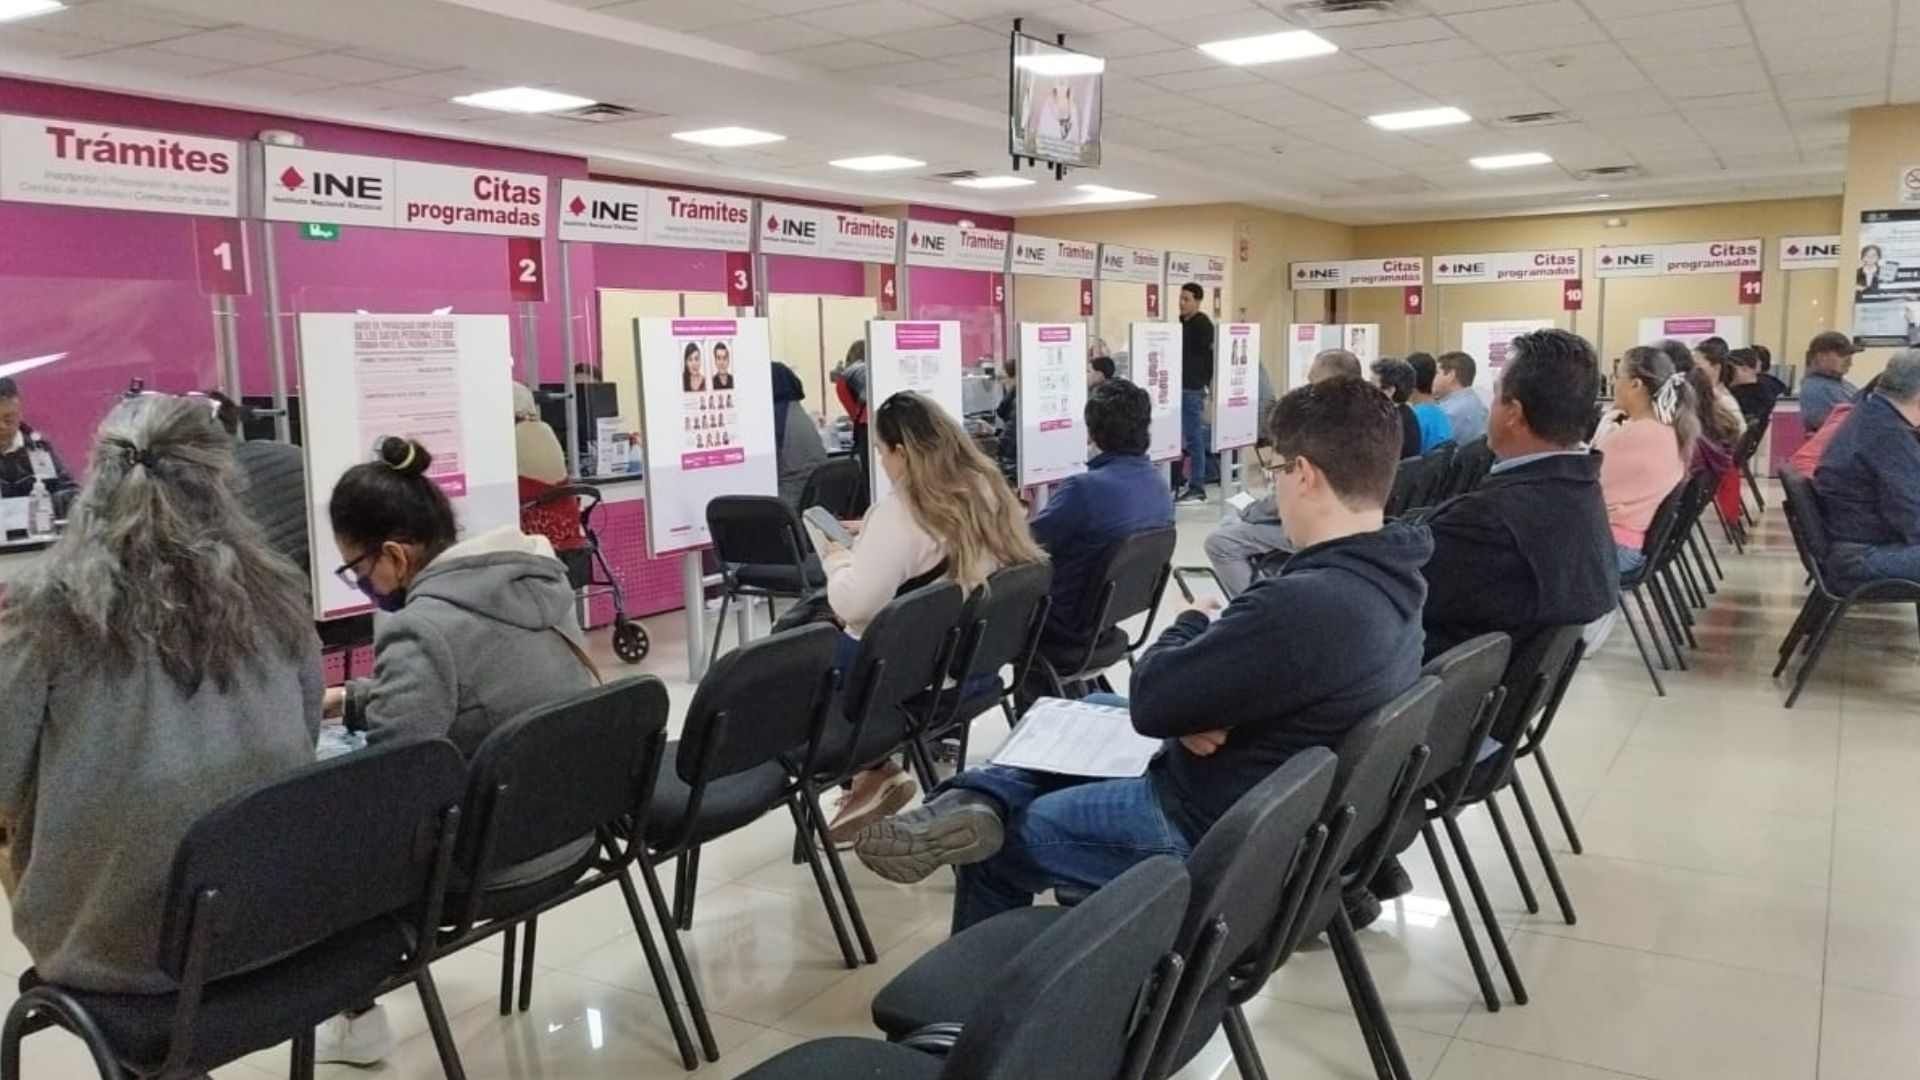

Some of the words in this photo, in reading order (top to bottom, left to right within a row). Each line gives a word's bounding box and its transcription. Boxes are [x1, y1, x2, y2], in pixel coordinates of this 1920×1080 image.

[46, 126, 229, 174] Trámites
[313, 172, 382, 201] INE
[474, 175, 541, 205] Citas
[407, 202, 540, 226] programadas
[592, 200, 638, 222] INE
[667, 196, 748, 223] Trámites
[782, 219, 816, 238] INE
[836, 215, 895, 239] Trámites
[921, 234, 945, 251] INE
[1709, 243, 1757, 257] Citas
[213, 242, 234, 271] 1
[1025, 246, 1046, 261] INE
[1534, 253, 1576, 266] Citas
[1617, 254, 1654, 265] INE
[519, 259, 537, 283] 2
[1383, 260, 1420, 273] Citas
[1453, 262, 1485, 273] INE
[1667, 257, 1757, 271] programadas
[734, 270, 748, 290] 3
[1309, 268, 1339, 279] INE
[1497, 266, 1576, 279] programadas
[884, 280, 894, 297] 4
[995, 286, 1003, 301] 5
[1566, 289, 1581, 301] 10
[1743, 281, 1761, 294] 11
[1149, 294, 1157, 308] 7
[1408, 294, 1419, 307] 9
